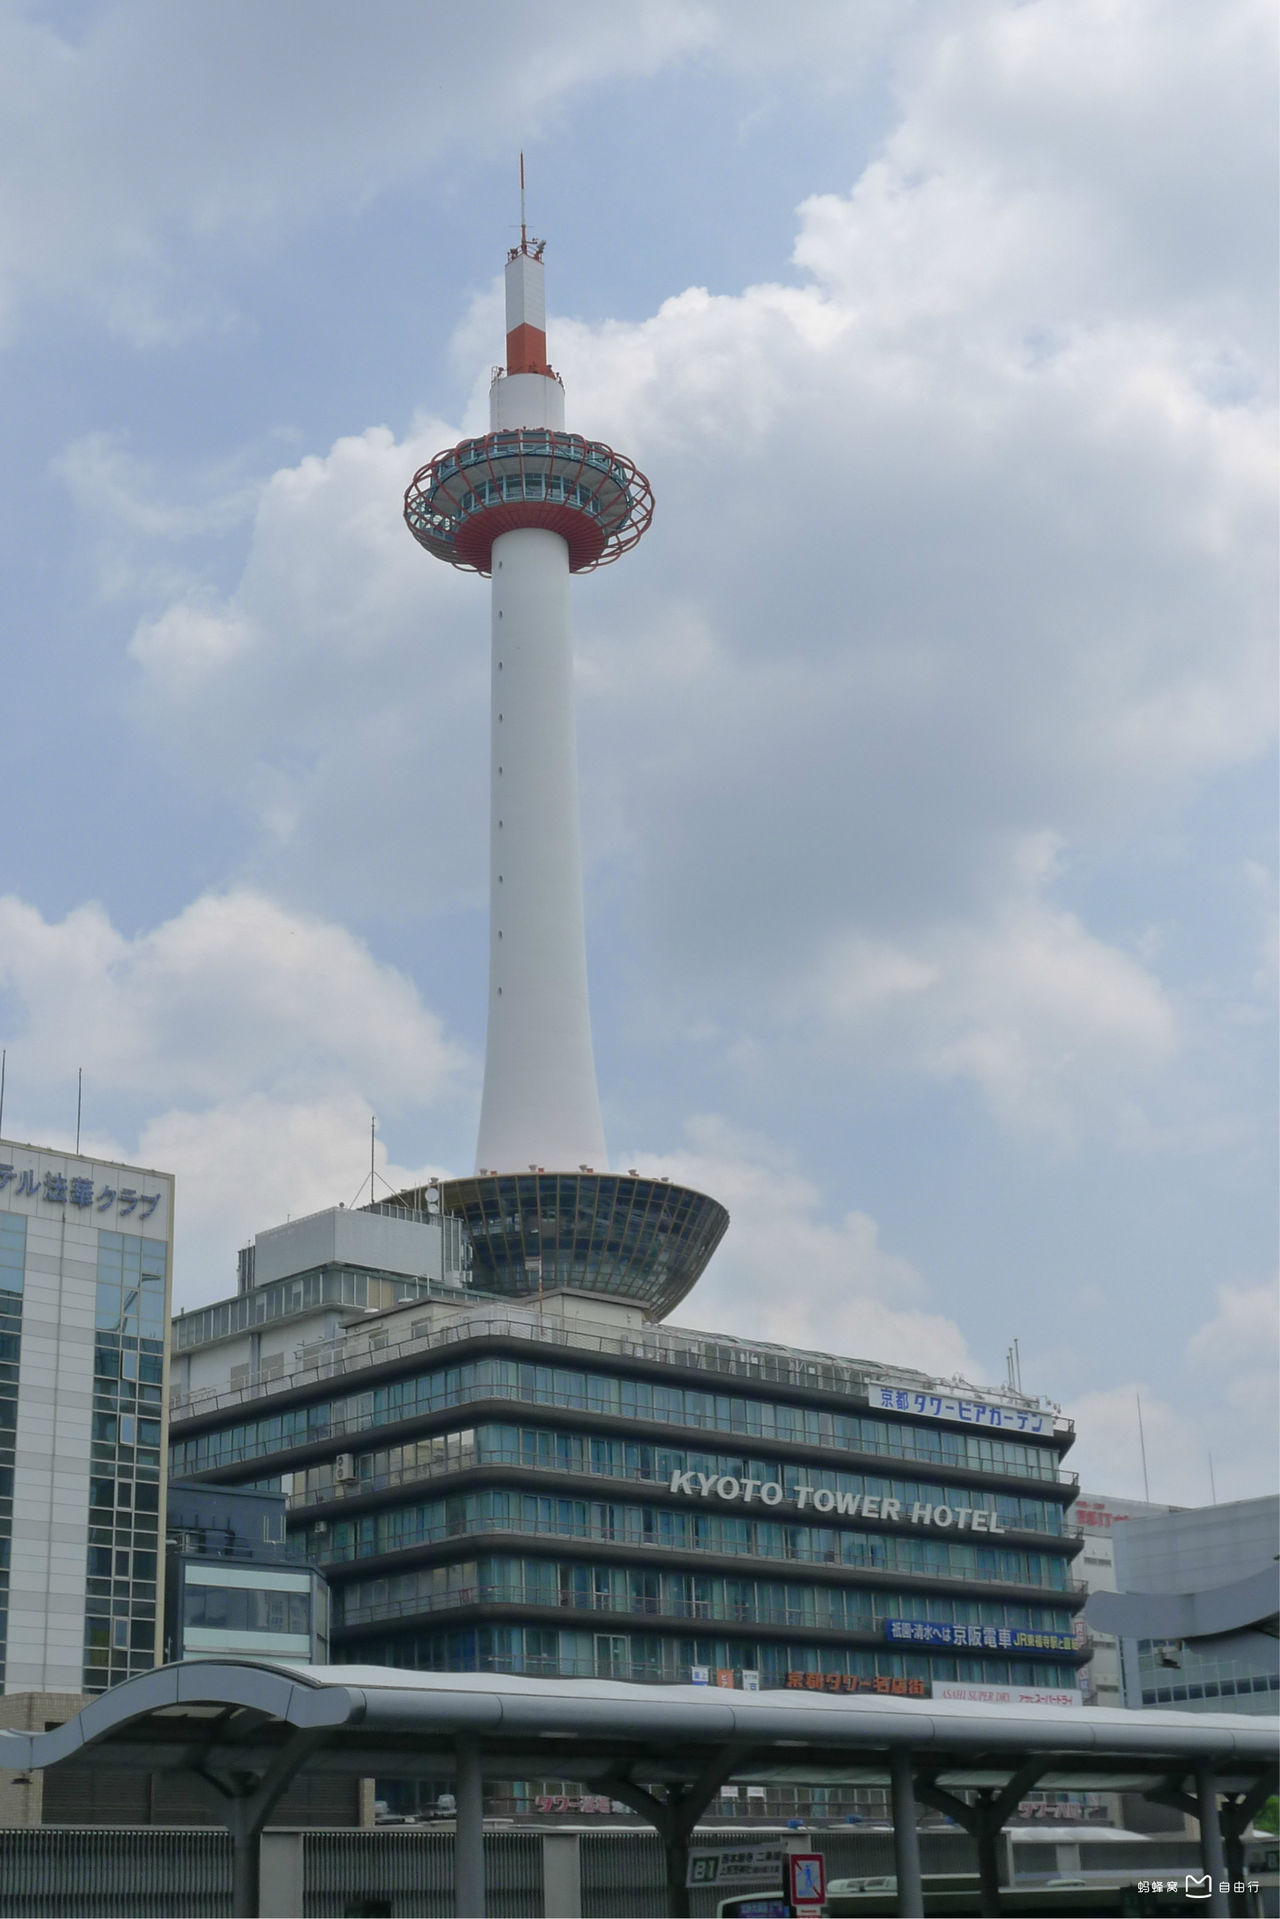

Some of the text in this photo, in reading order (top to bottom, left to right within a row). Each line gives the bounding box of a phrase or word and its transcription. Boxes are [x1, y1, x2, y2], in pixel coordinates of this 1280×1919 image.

[880, 1388, 1043, 1433] 京都タワービアガーデン
[669, 1469, 1006, 1534] KYOTO TOWER HOTEL
[786, 1671, 925, 1695] 京都タワー名店街
